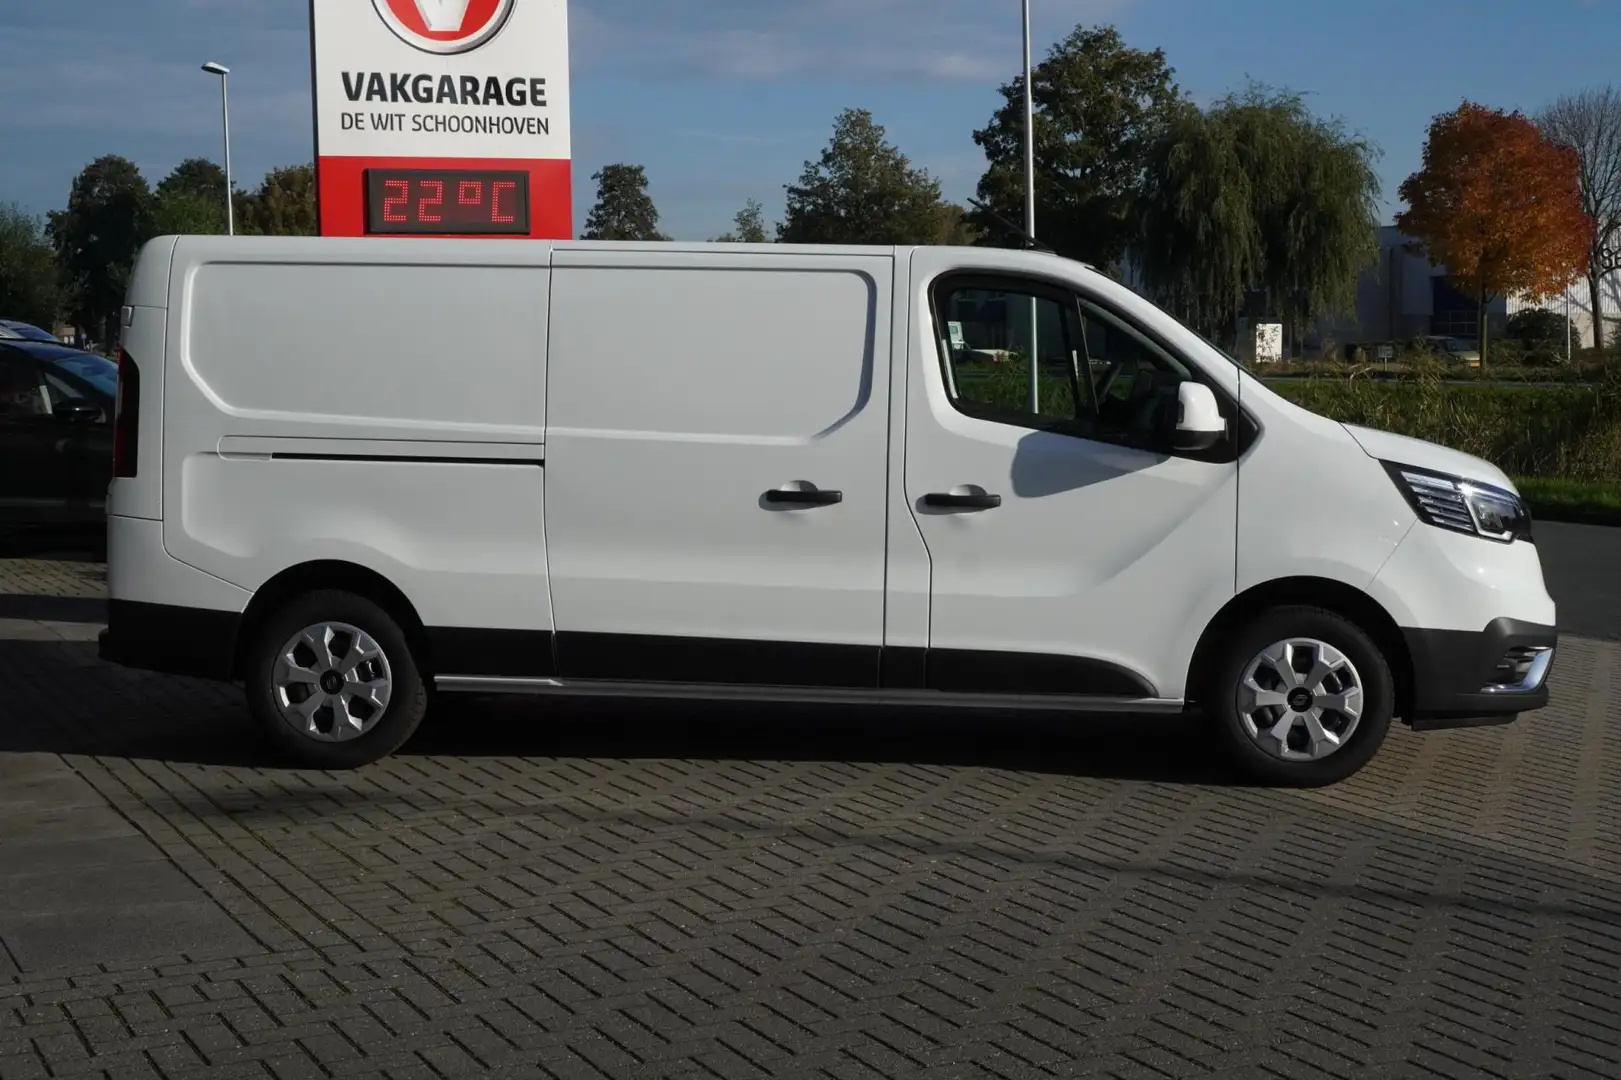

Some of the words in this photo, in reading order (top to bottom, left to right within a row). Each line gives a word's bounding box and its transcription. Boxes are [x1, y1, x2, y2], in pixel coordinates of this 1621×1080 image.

[341, 71, 547, 107] VAKGARAGE
[341, 112, 365, 131] DE
[370, 112, 406, 132] WIT
[411, 114, 549, 136] SCHOONHOVEN
